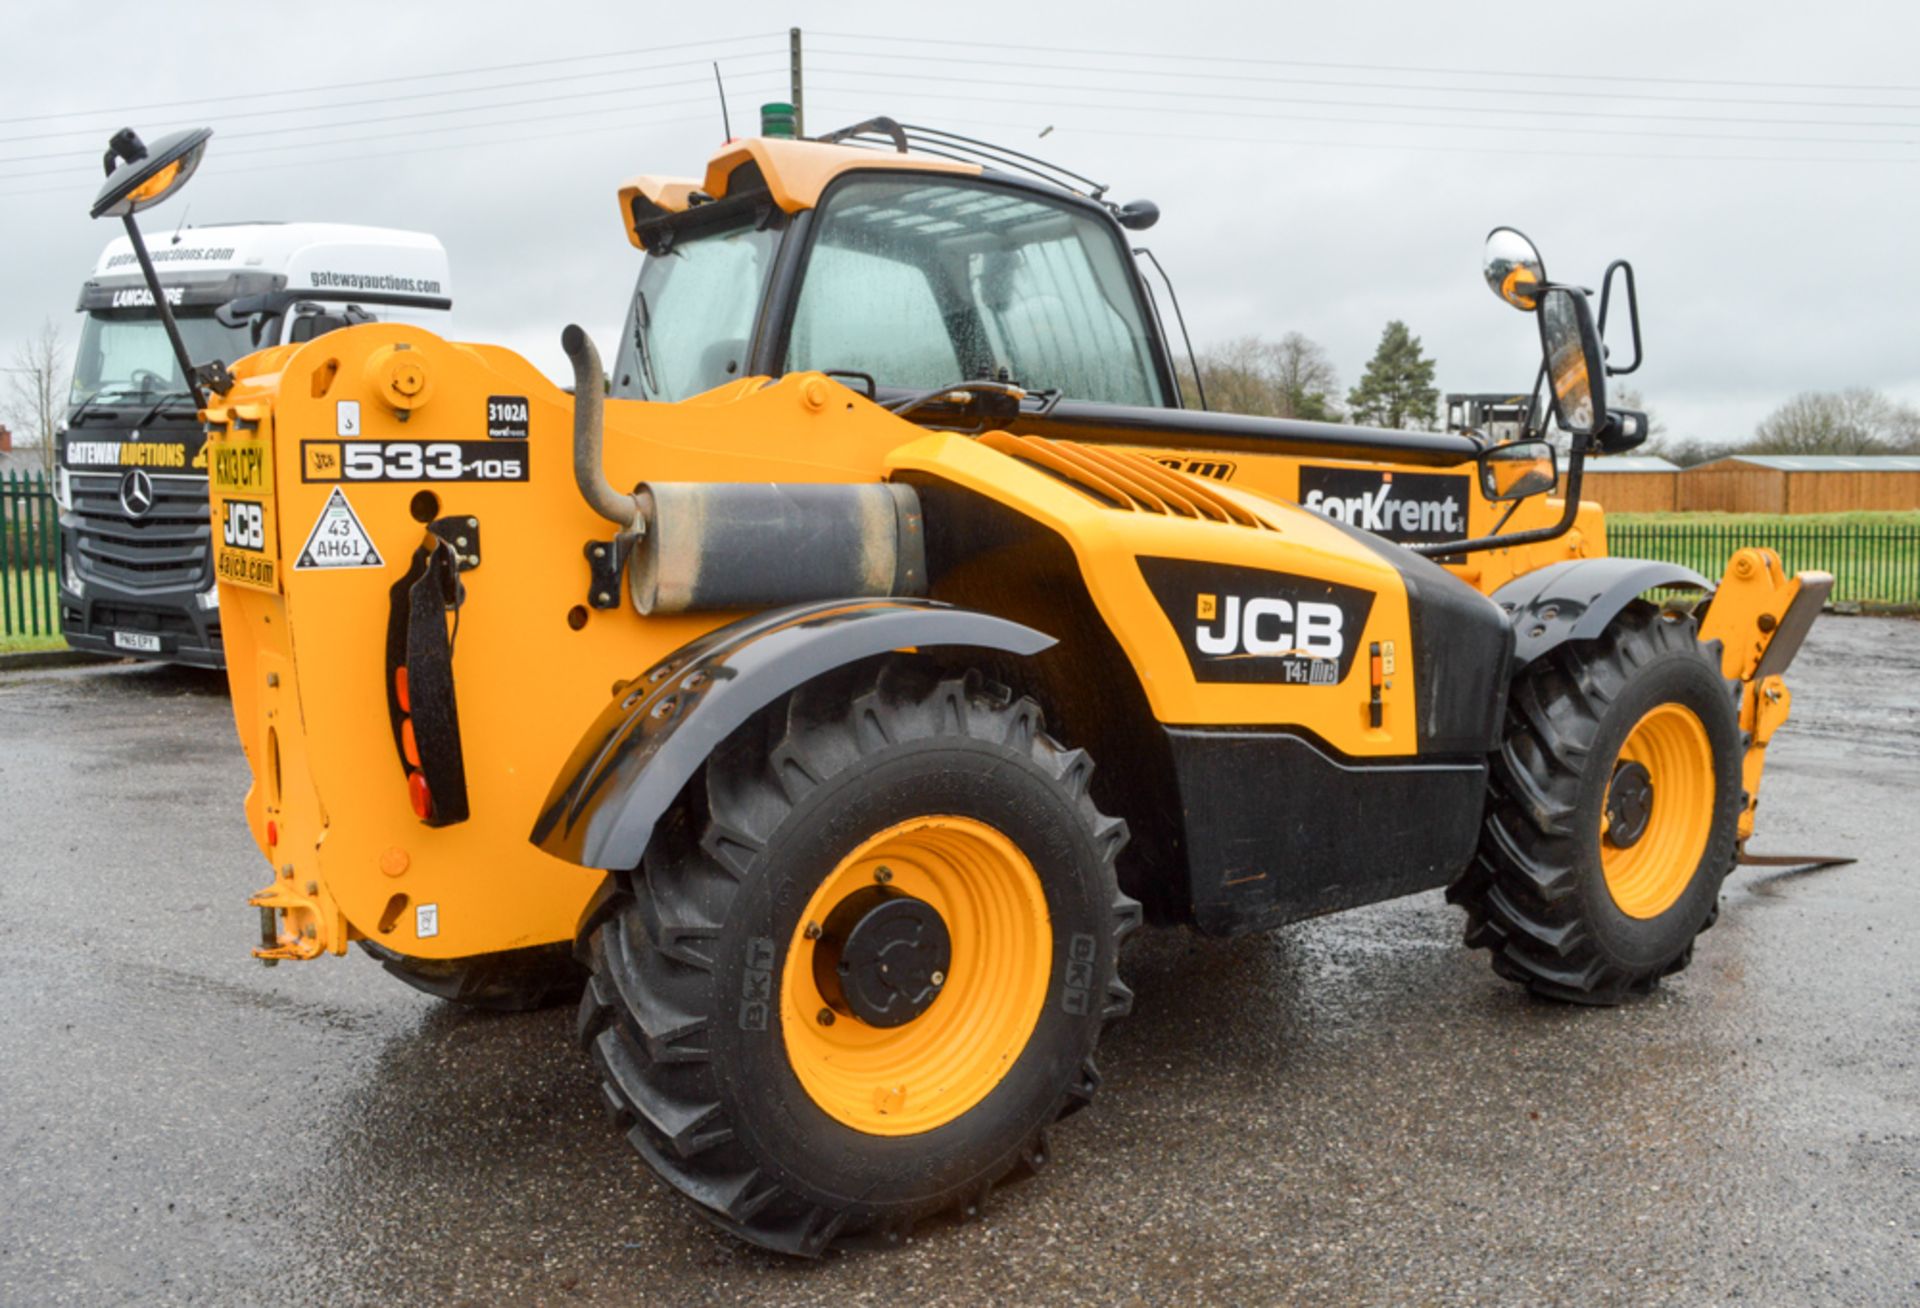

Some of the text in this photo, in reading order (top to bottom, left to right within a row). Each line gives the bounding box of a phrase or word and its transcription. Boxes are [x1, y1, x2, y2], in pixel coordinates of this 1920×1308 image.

[311, 271, 441, 293] gatewayauctions.com
[489, 403, 527, 421] 3102A
[241, 447, 263, 487] CPY
[224, 503, 264, 549] JCB
[328, 519, 351, 537] 43
[317, 540, 360, 558] AH61
[1196, 596, 1344, 658] JCB
[740, 937, 775, 1030] BKT
[1062, 932, 1096, 1016] BKT
